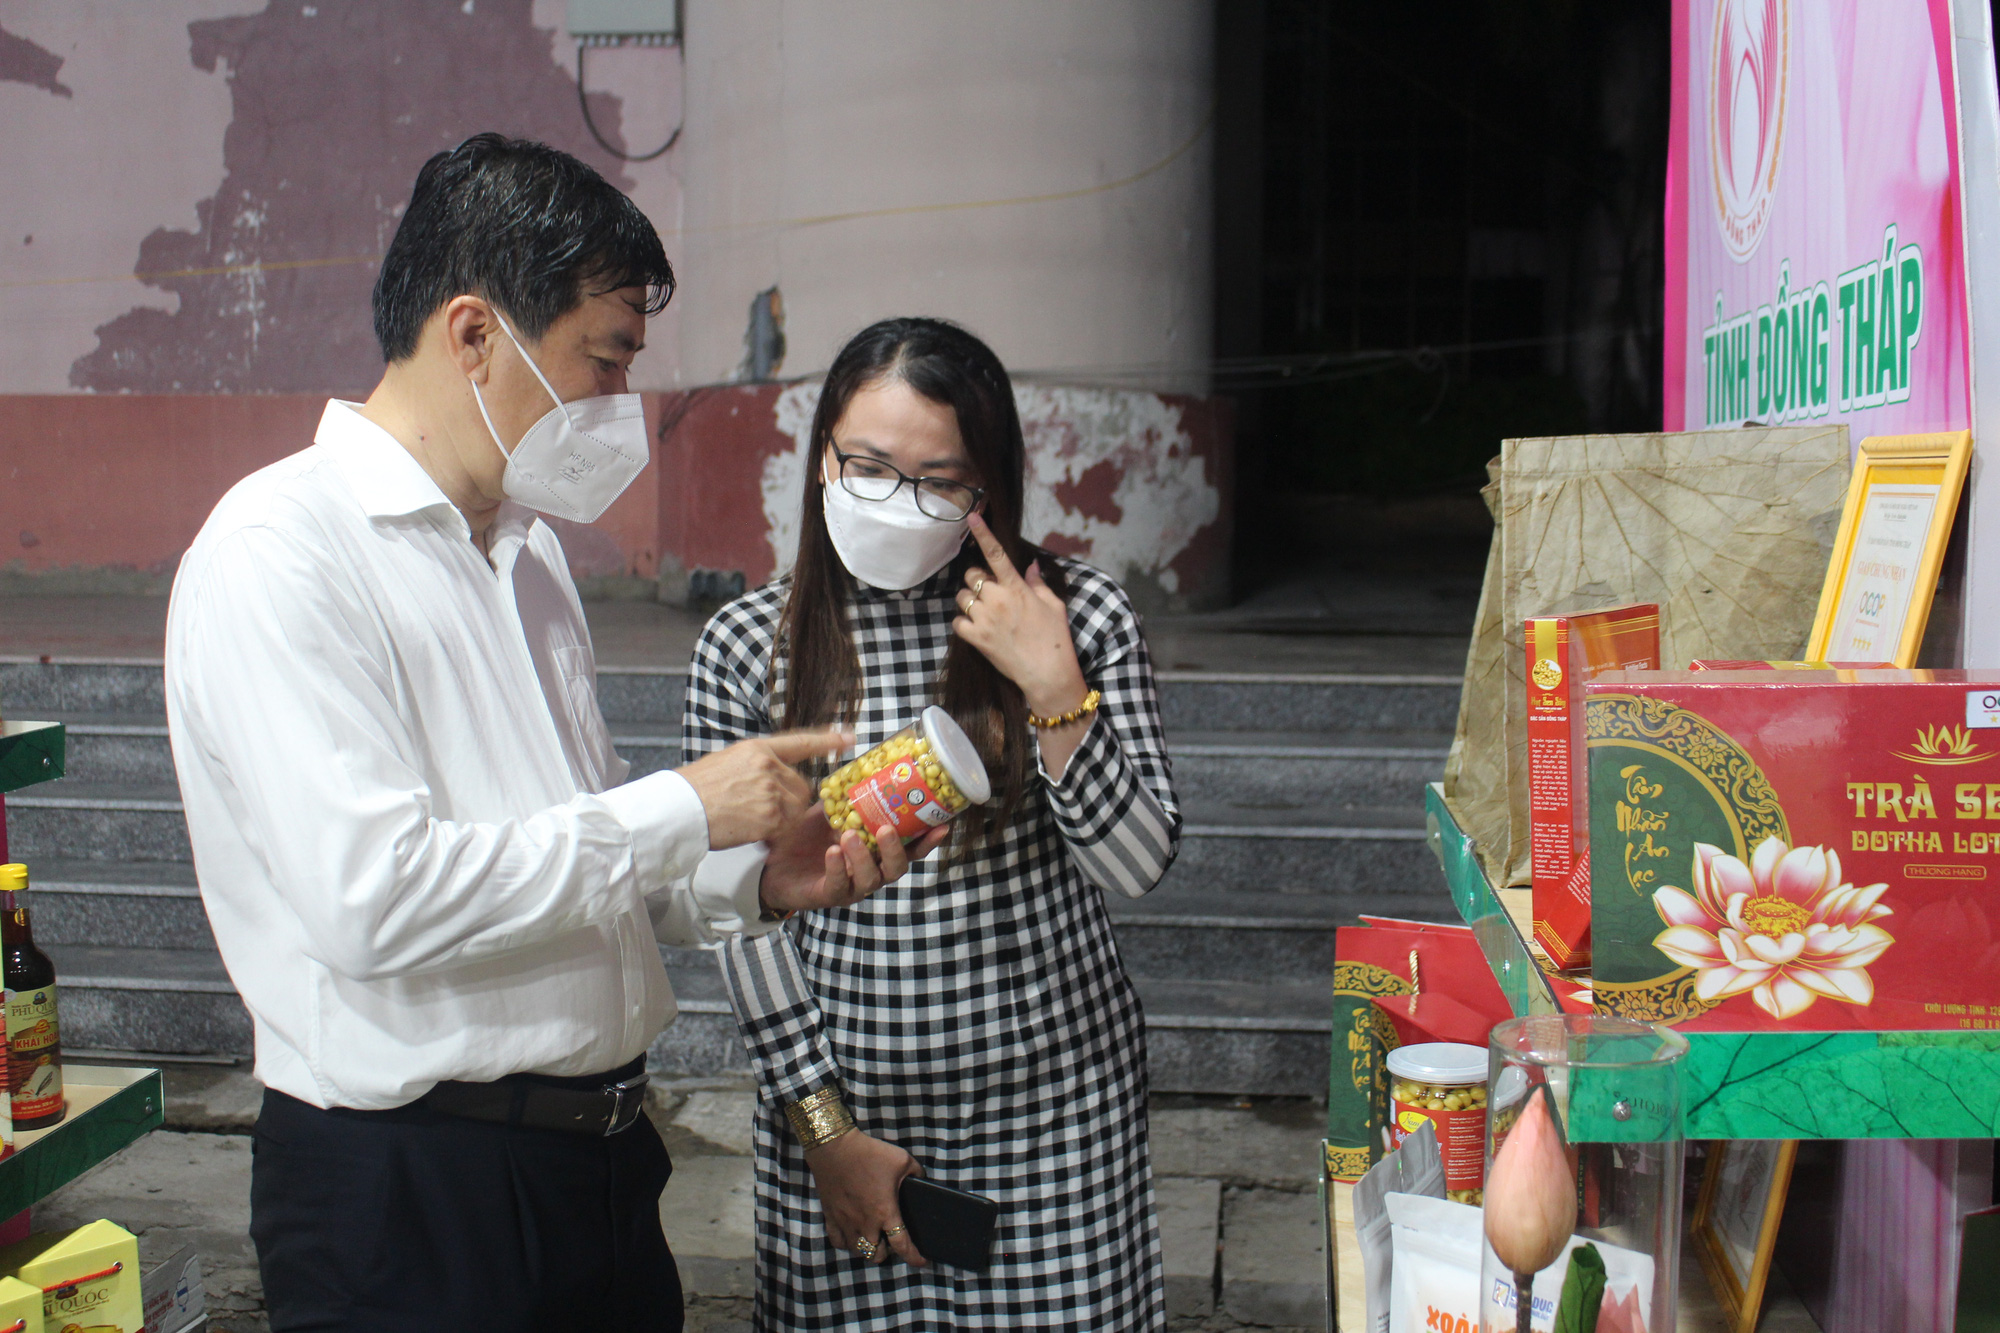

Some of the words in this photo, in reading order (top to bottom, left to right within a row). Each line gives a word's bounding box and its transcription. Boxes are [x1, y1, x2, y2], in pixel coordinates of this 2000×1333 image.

[1704, 299, 1750, 426] TỈNH
[1757, 270, 1829, 416] ĐỒNG
[1838, 236, 1922, 400] THÁP
[1858, 591, 1886, 617] OCOP
[1846, 773, 1938, 823] TRÀ
[1851, 830, 1944, 853] DOTHA
[16, 1036, 40, 1048] KHẢI
